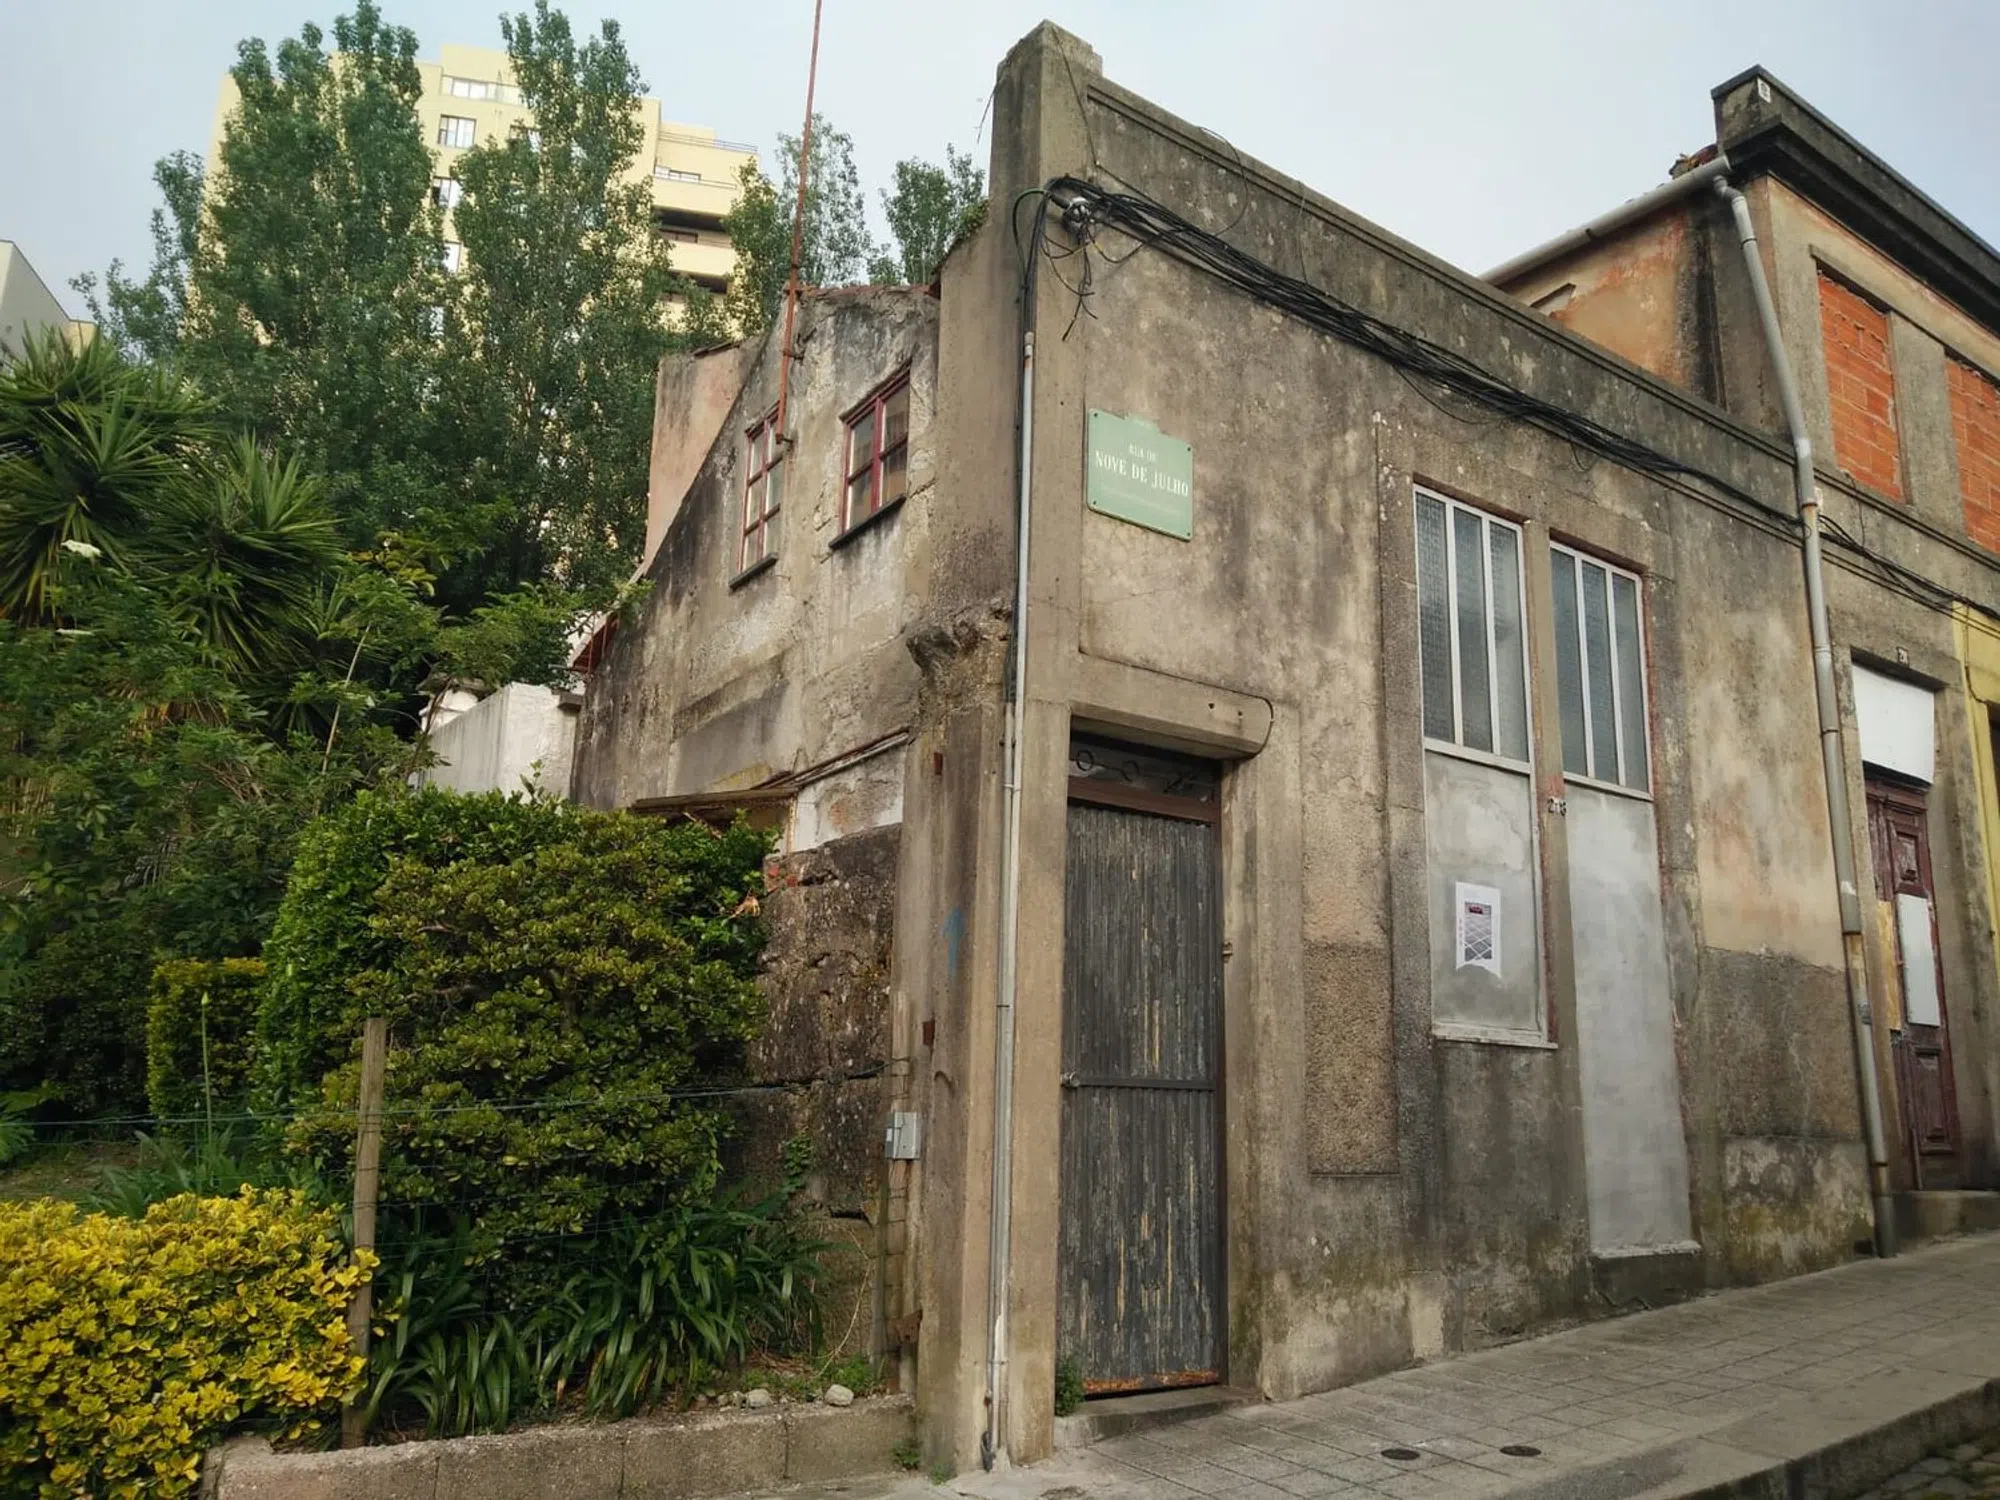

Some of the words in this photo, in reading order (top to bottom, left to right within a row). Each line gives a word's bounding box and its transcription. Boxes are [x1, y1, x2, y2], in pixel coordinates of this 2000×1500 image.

[1096, 450, 1127, 475] NOVE
[1132, 463, 1147, 483] DE
[1152, 471, 1188, 497] JULHO
